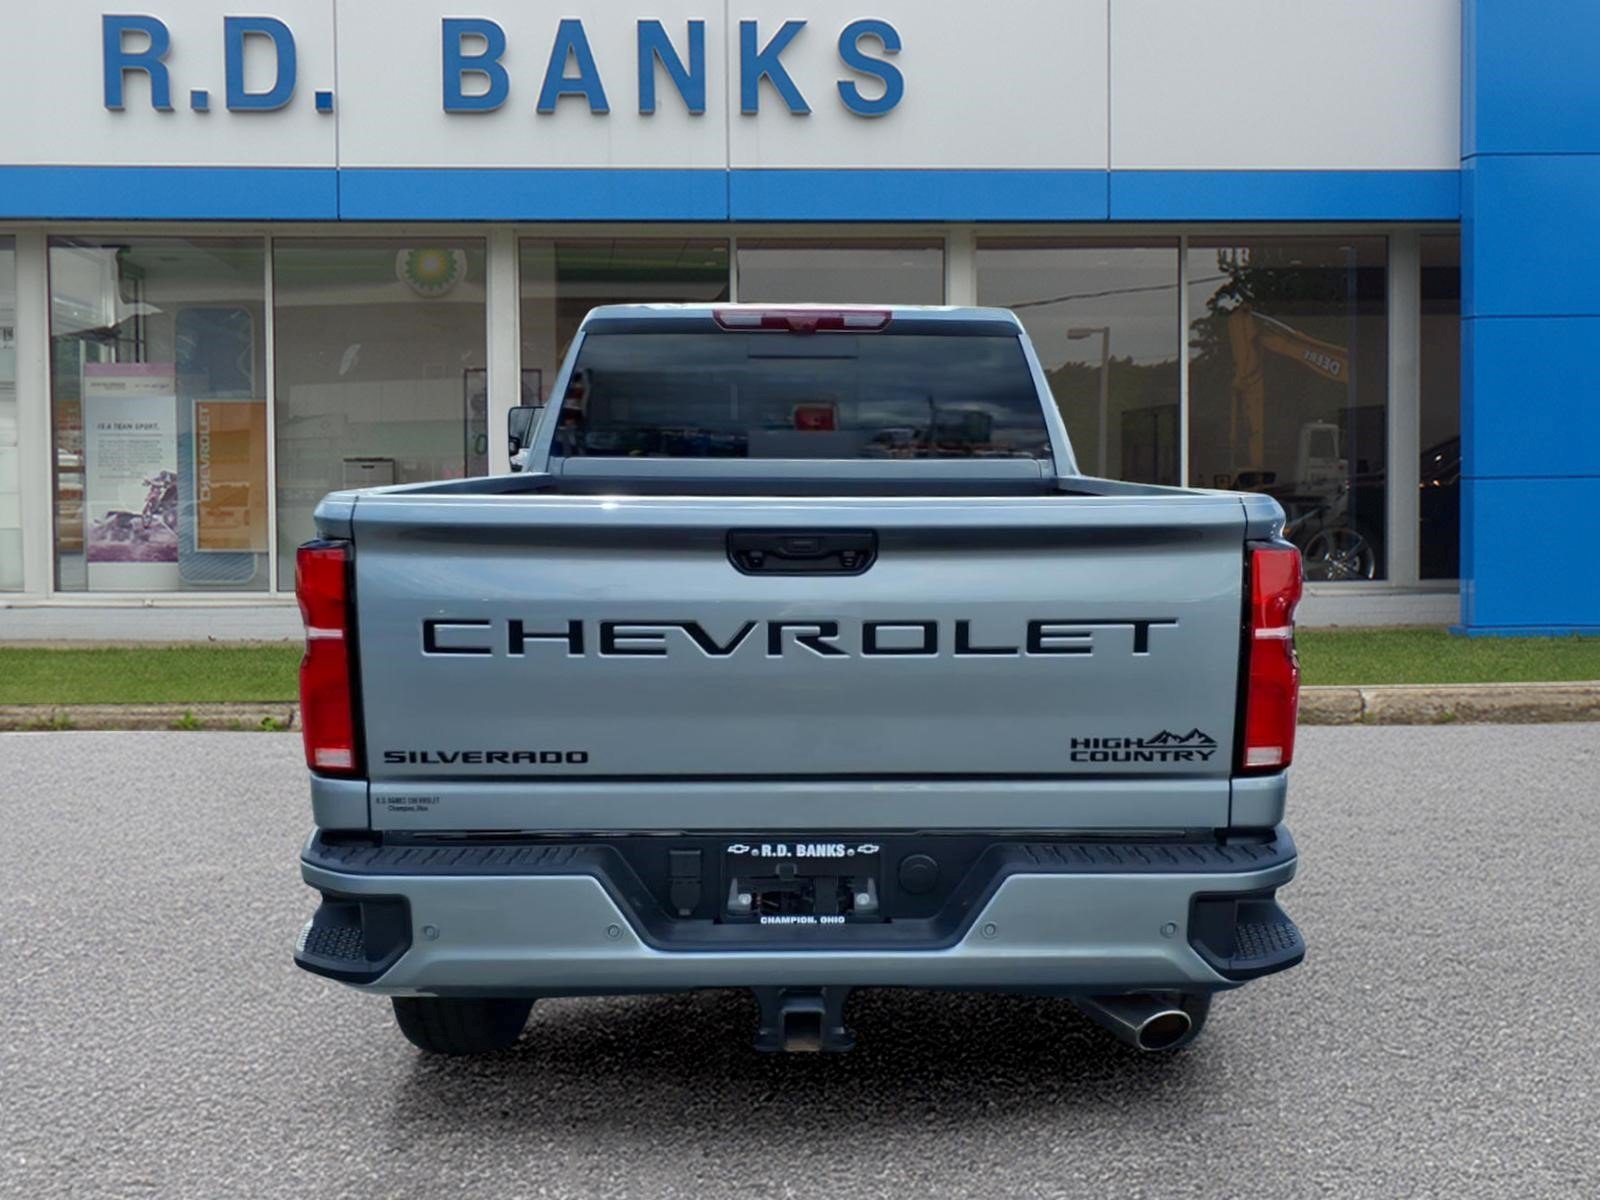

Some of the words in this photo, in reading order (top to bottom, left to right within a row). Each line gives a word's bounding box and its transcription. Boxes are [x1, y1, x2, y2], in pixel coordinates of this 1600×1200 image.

[101, 14, 333, 112] R.D.
[441, 17, 905, 118] BANKS
[106, 422, 112, 430] A
[113, 422, 133, 430] TEAM
[200, 406, 211, 501] CHEVROLET
[421, 618, 1178, 658] CHEVROLET
[1070, 737, 1144, 749] HIGH
[383, 751, 589, 764] SILVERADO
[1070, 750, 1217, 762] COUNTRY
[761, 844, 792, 857] R.D.
[796, 844, 846, 857] BANKS
[820, 916, 845, 924] OHIO
